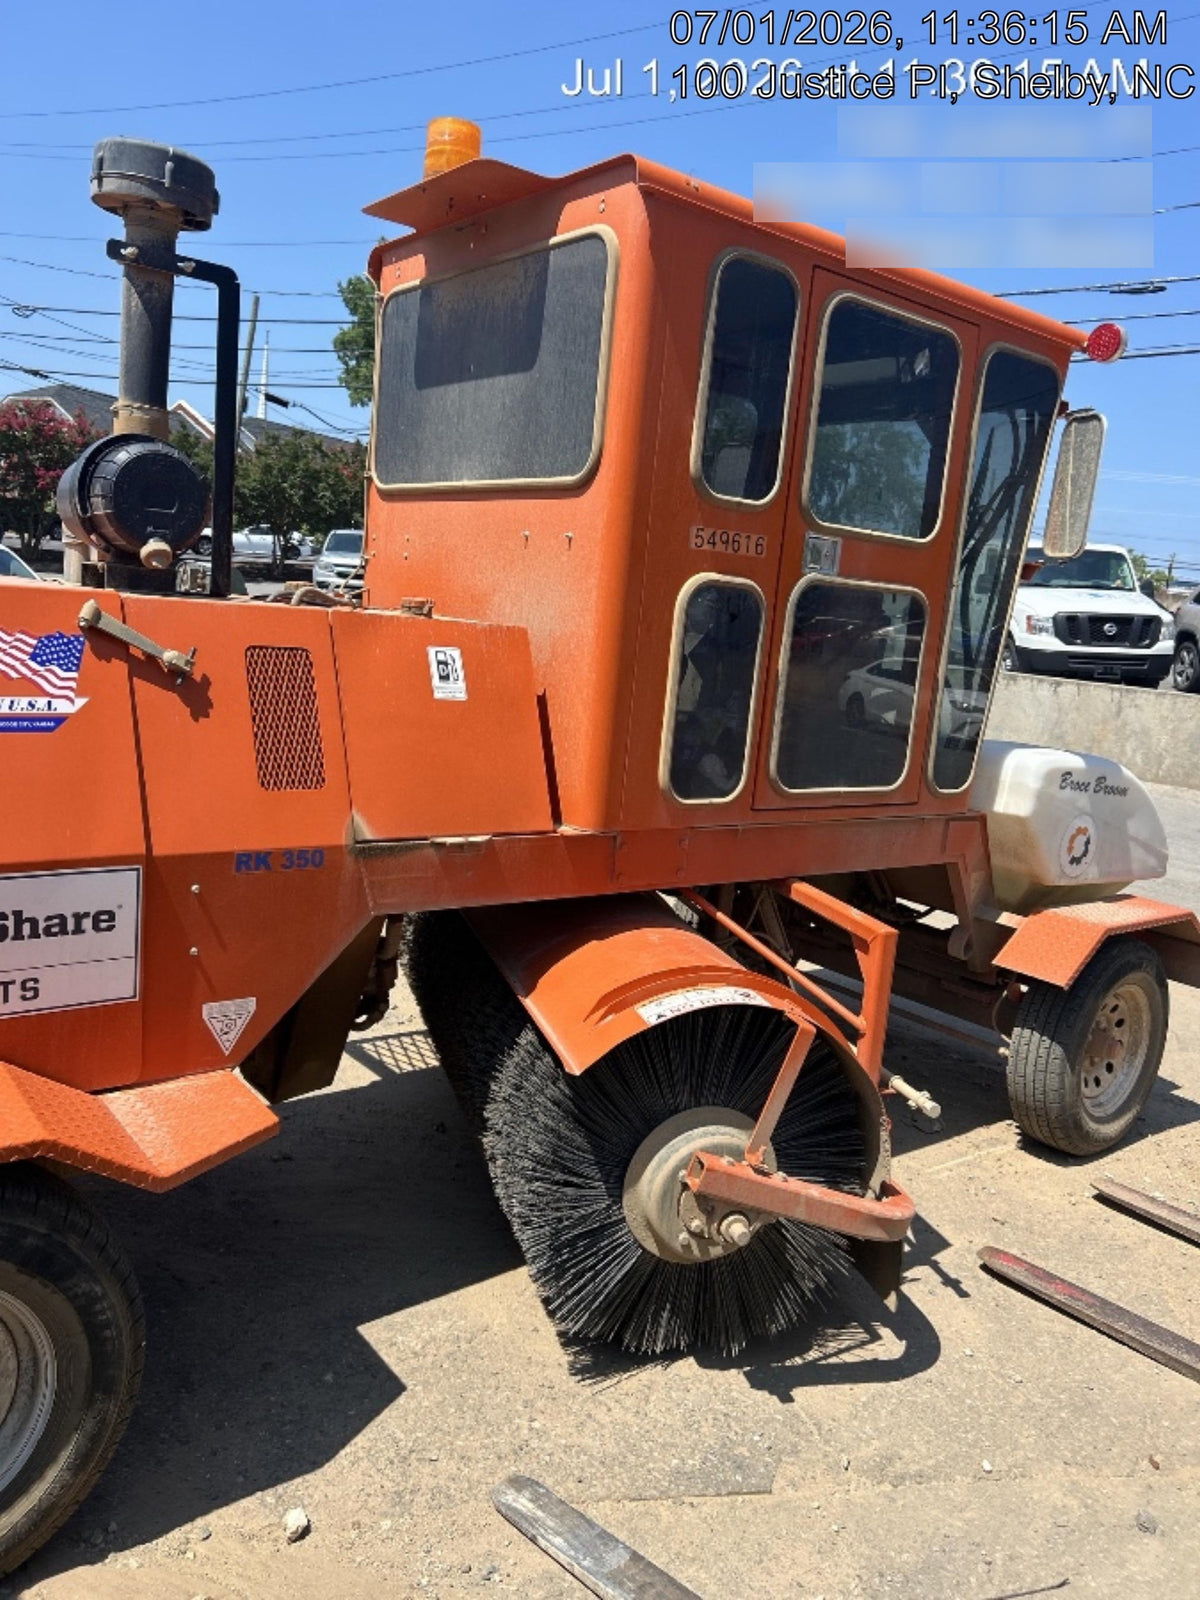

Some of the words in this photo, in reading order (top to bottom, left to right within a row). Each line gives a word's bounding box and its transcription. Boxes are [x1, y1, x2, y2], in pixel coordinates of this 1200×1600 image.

[694, 527, 766, 555] 549616
[8, 697, 57, 712] U.S.A.
[1059, 771, 1092, 793] Broce
[1093, 776, 1131, 798] Broom
[234, 851, 274, 874] RK
[280, 848, 326, 870] 350
